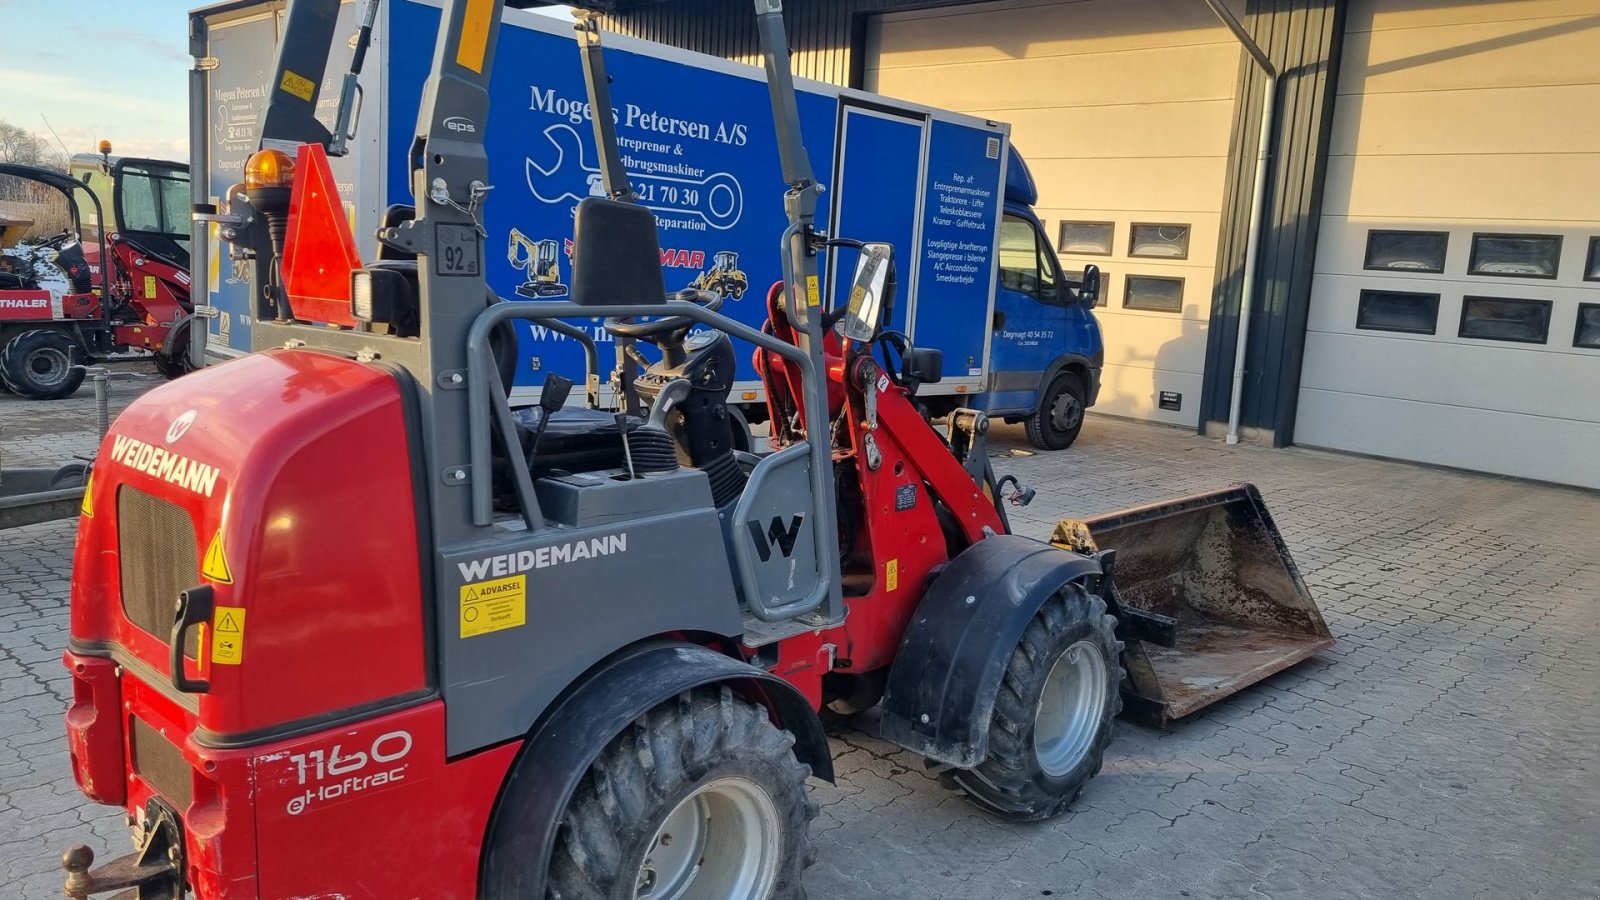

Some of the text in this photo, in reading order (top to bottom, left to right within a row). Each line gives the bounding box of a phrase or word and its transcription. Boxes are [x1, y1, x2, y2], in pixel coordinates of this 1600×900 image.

[237, 87, 260, 100] Petersen
[529, 85, 747, 146] Moges Petersen A/S
[447, 122, 476, 133] eps
[616, 136, 683, 155] treprenør &
[620, 155, 704, 177] dbrugsmaskiner
[953, 172, 966, 184] Rep.
[638, 183, 699, 206] 21 70 30
[933, 181, 990, 197] Entreprenørmaskiner
[972, 198, 984, 208] Lifte
[932, 216, 951, 226] Kraner
[445, 246, 464, 271] 92
[658, 248, 705, 269] MAR
[945, 263, 978, 272] Aircondition
[0, 299, 47, 308] THALER
[110, 434, 220, 497] WEIDEMANN
[747, 512, 806, 562] W
[457, 533, 627, 582] WEIDEMANN
[480, 582, 520, 596] ADVARSEL
[290, 730, 412, 784] 1160
